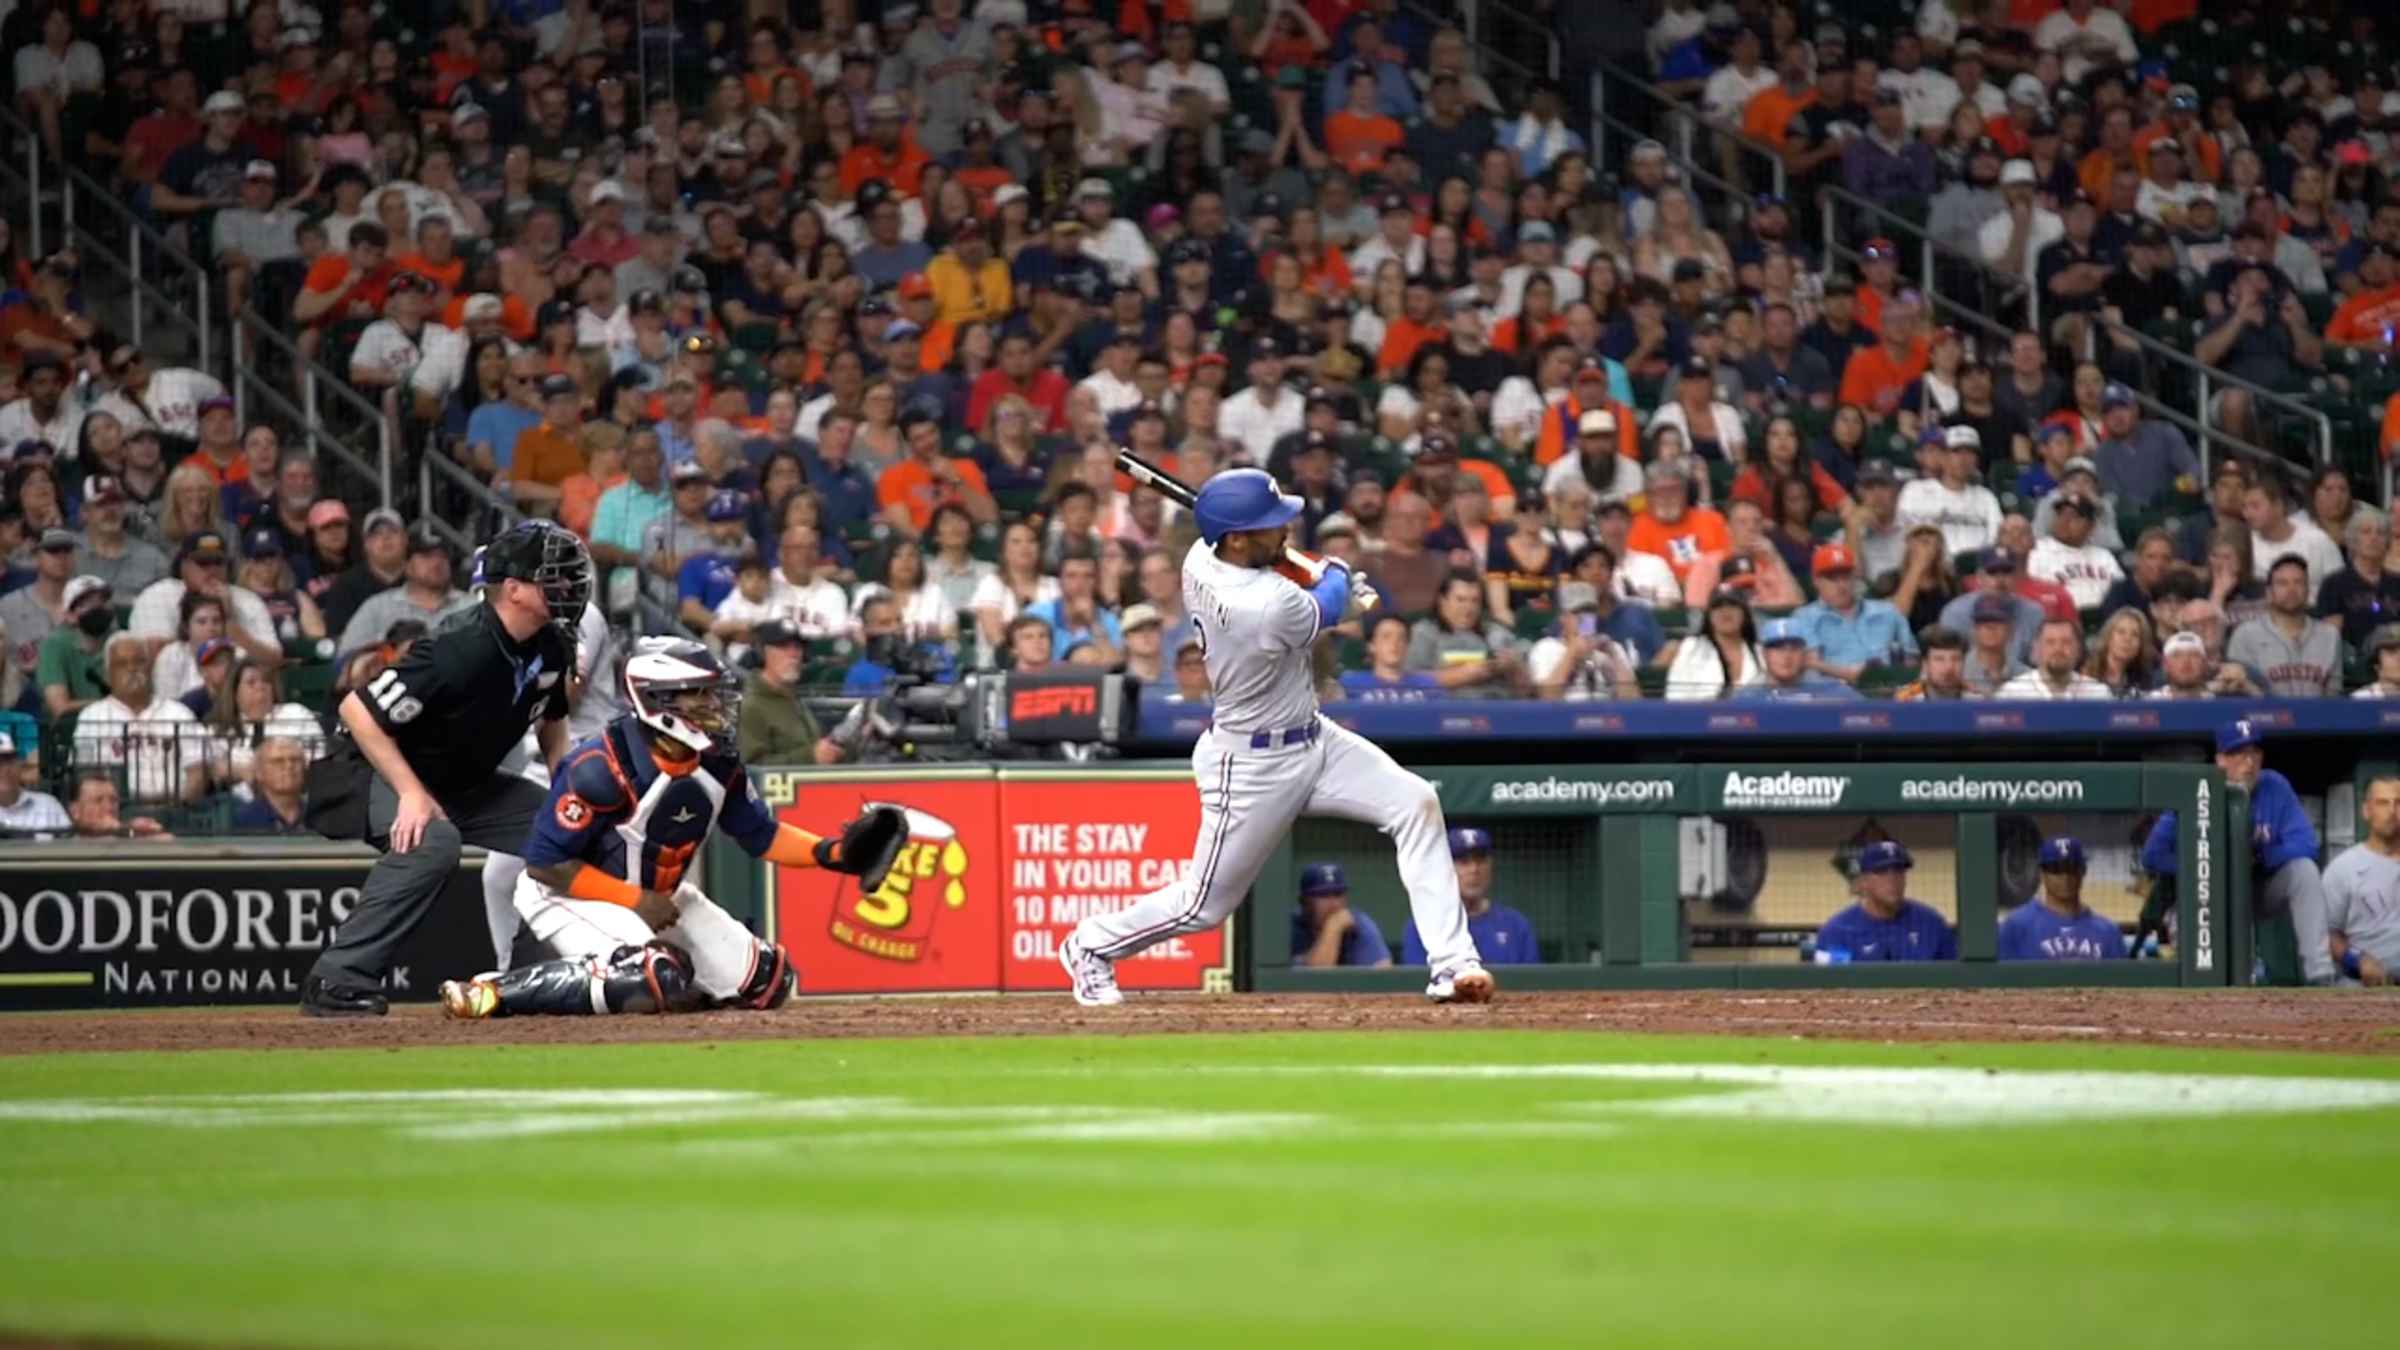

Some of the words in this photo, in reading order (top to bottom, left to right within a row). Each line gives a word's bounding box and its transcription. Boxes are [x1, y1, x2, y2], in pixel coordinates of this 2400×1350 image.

[367, 669, 423, 724] 118
[1011, 685, 1095, 720] ESPN
[1492, 776, 1675, 804] academy.com
[1723, 770, 1843, 803] Academy
[1901, 775, 2083, 804] academy.com
[1013, 824, 1070, 853] THE
[1076, 824, 1148, 853] STAY
[892, 841, 940, 877] KE
[1013, 859, 1046, 888] IN
[1053, 859, 1133, 888] YOUR
[854, 871, 912, 929] 5
[1014, 896, 1045, 925] 10
[1013, 930, 1057, 960] OIL
[2040, 935, 2102, 958] TEXAS
[104, 961, 299, 993] NATIONAL
